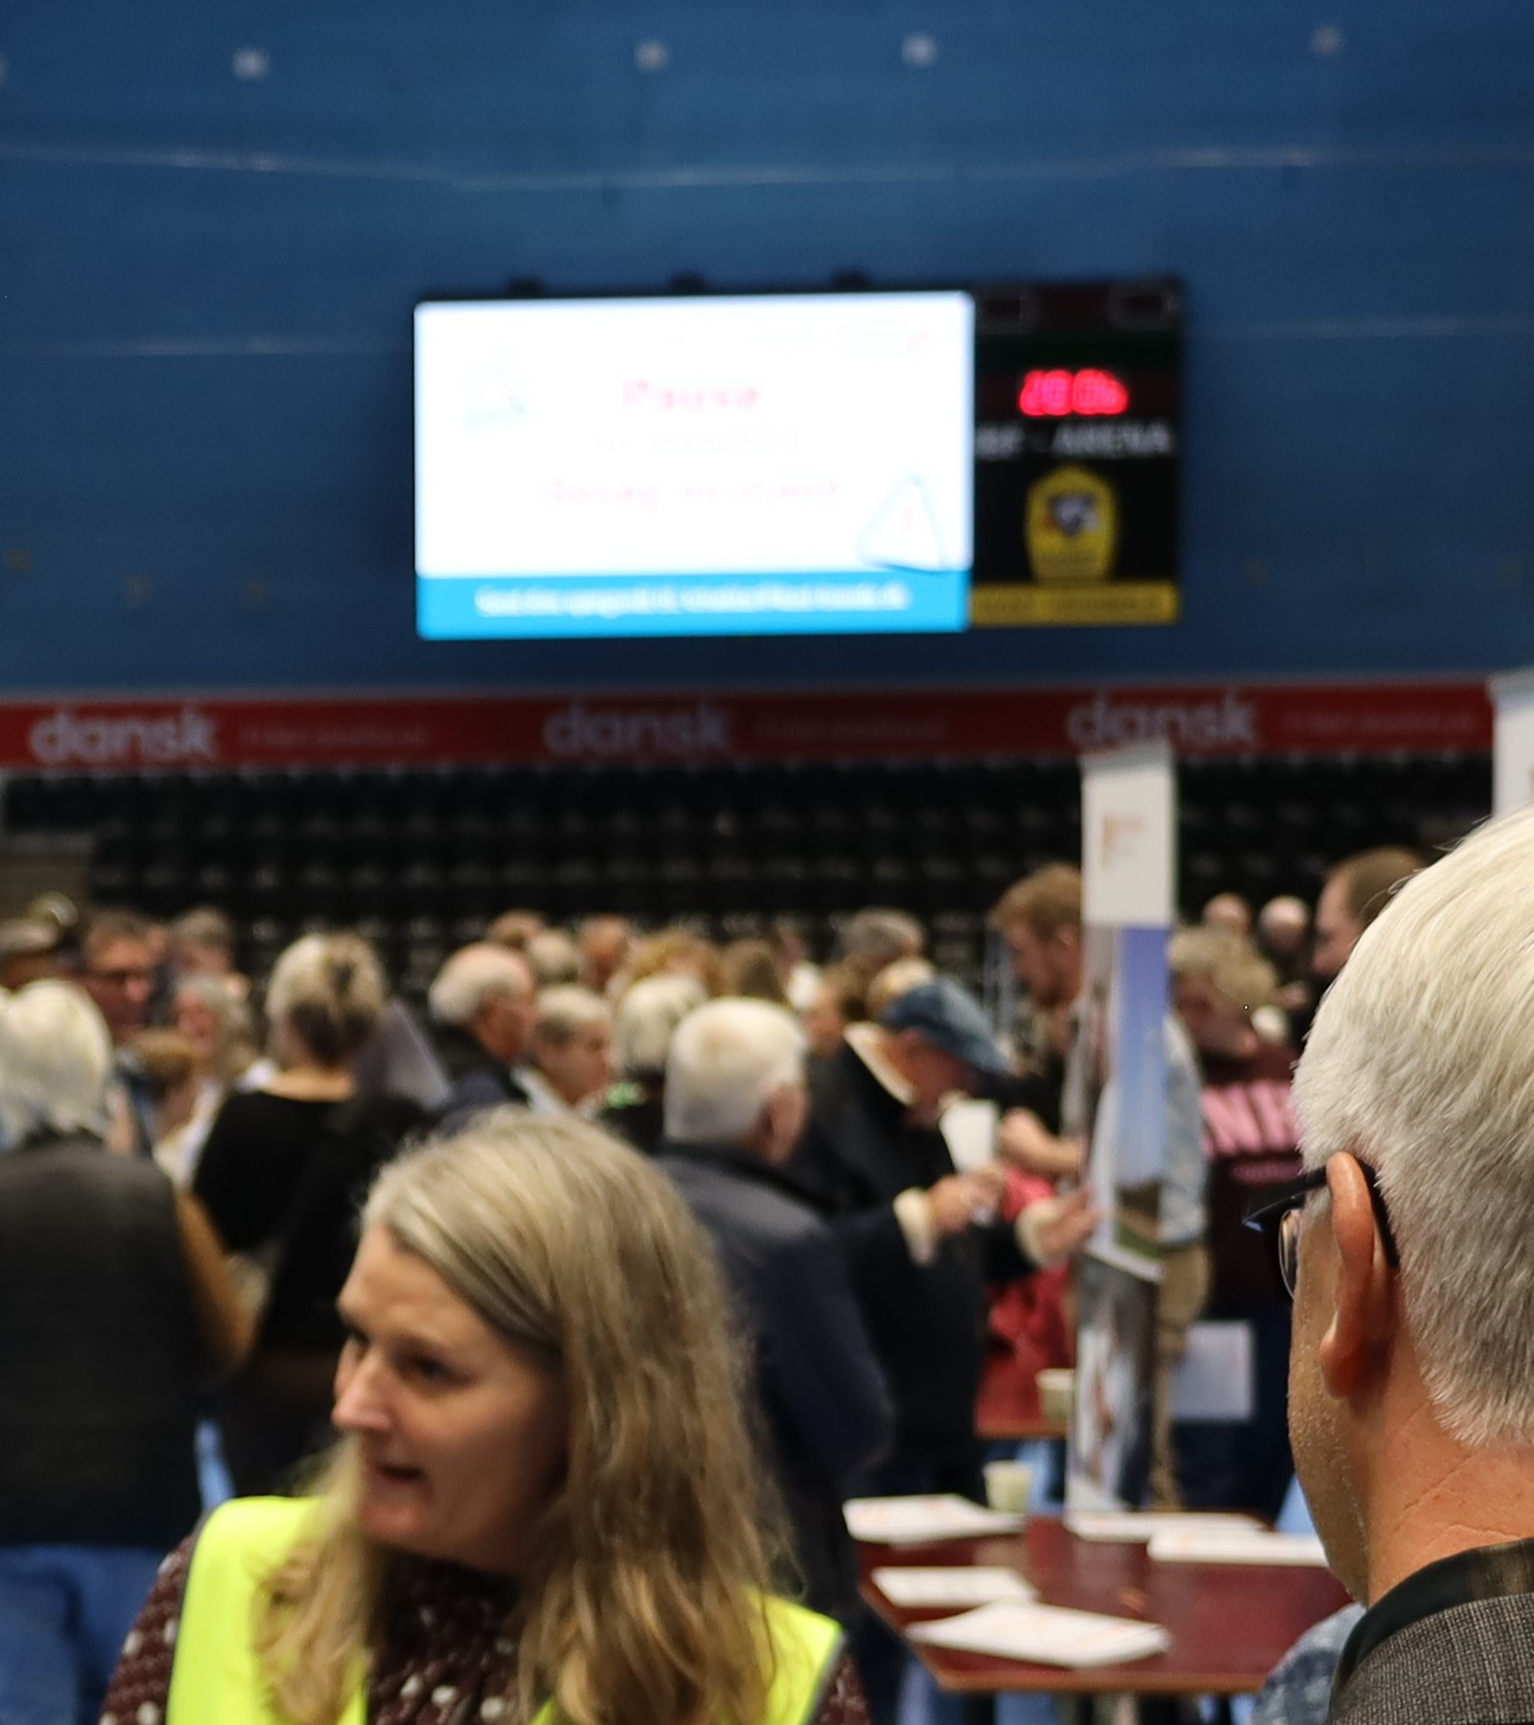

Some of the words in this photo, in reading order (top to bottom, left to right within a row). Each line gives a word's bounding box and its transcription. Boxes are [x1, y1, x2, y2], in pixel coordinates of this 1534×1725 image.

[29, 704, 222, 767] dansk
[543, 697, 736, 757] dansk
[1068, 690, 1261, 752] dansk
